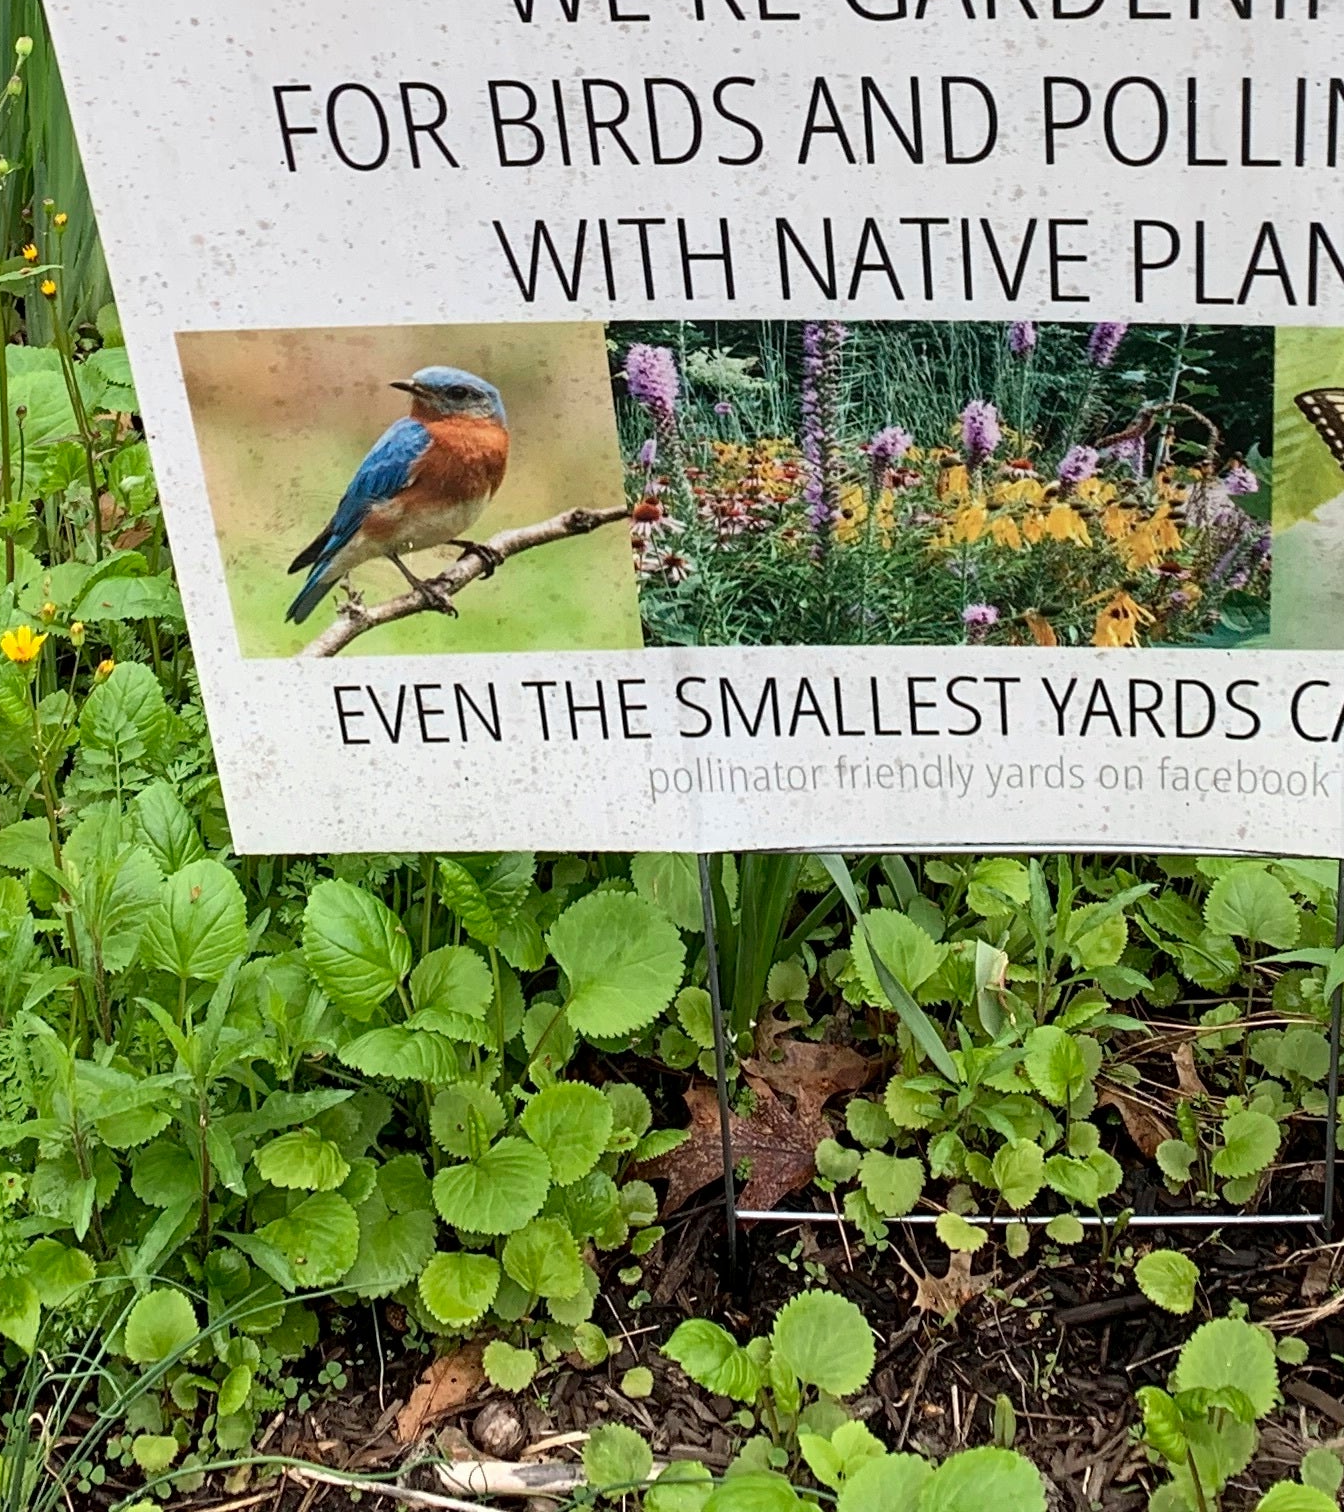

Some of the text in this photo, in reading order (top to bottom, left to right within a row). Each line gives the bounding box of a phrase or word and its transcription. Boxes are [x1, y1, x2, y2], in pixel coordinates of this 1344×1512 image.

[273, 82, 460, 172] FOR
[488, 77, 763, 167] BIRDS
[798, 76, 998, 164] AND
[492, 218, 735, 302] WITH
[776, 217, 1090, 302] NATIVE
[333, 682, 502, 745] EVEN
[521, 679, 652, 741] THE
[676, 676, 1021, 738] SMALLEST
[1041, 677, 1261, 740] YARDS
[649, 754, 1330, 804] pollinator friendly yards on facebook
